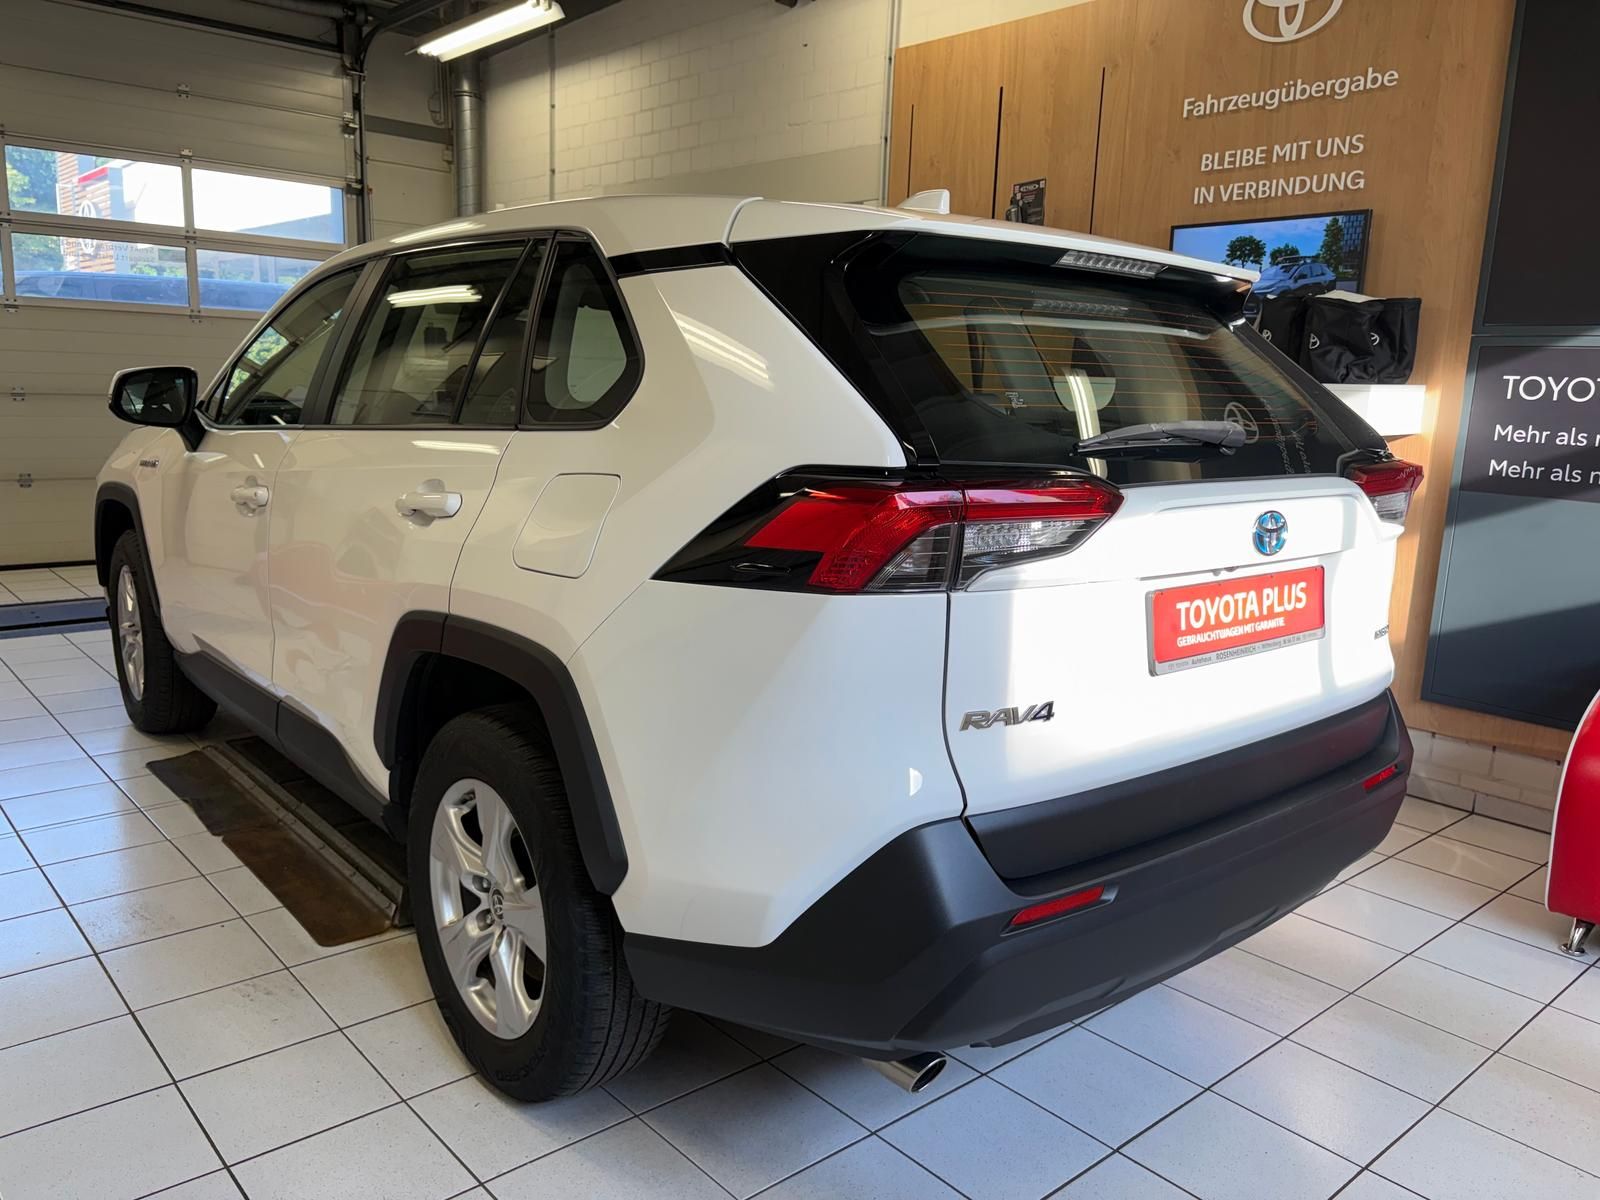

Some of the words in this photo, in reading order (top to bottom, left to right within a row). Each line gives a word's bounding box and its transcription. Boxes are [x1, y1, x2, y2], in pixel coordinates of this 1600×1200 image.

[1182, 67, 1399, 119] Fahrzeugübergabe
[1200, 146, 1267, 172] BLEIBE
[1272, 140, 1311, 163] MIT
[1316, 134, 1365, 158] UNS
[1193, 186, 1214, 205] IN
[1220, 170, 1365, 202] VERBINDUNG
[1502, 375, 1600, 403] TOYO
[1493, 424, 1550, 444] Mehr
[1555, 427, 1588, 447] als
[1488, 459, 1545, 480] Mehr
[1550, 464, 1582, 483] als
[1176, 591, 1259, 631] TOYOTA
[1263, 582, 1307, 615] PLUS
[1177, 626, 1245, 647] GEBRAUCHTWAGEN
[1244, 621, 1255, 634] MIT
[1255, 617, 1286, 631] GARANTIE
[960, 701, 1055, 731] RAV4
